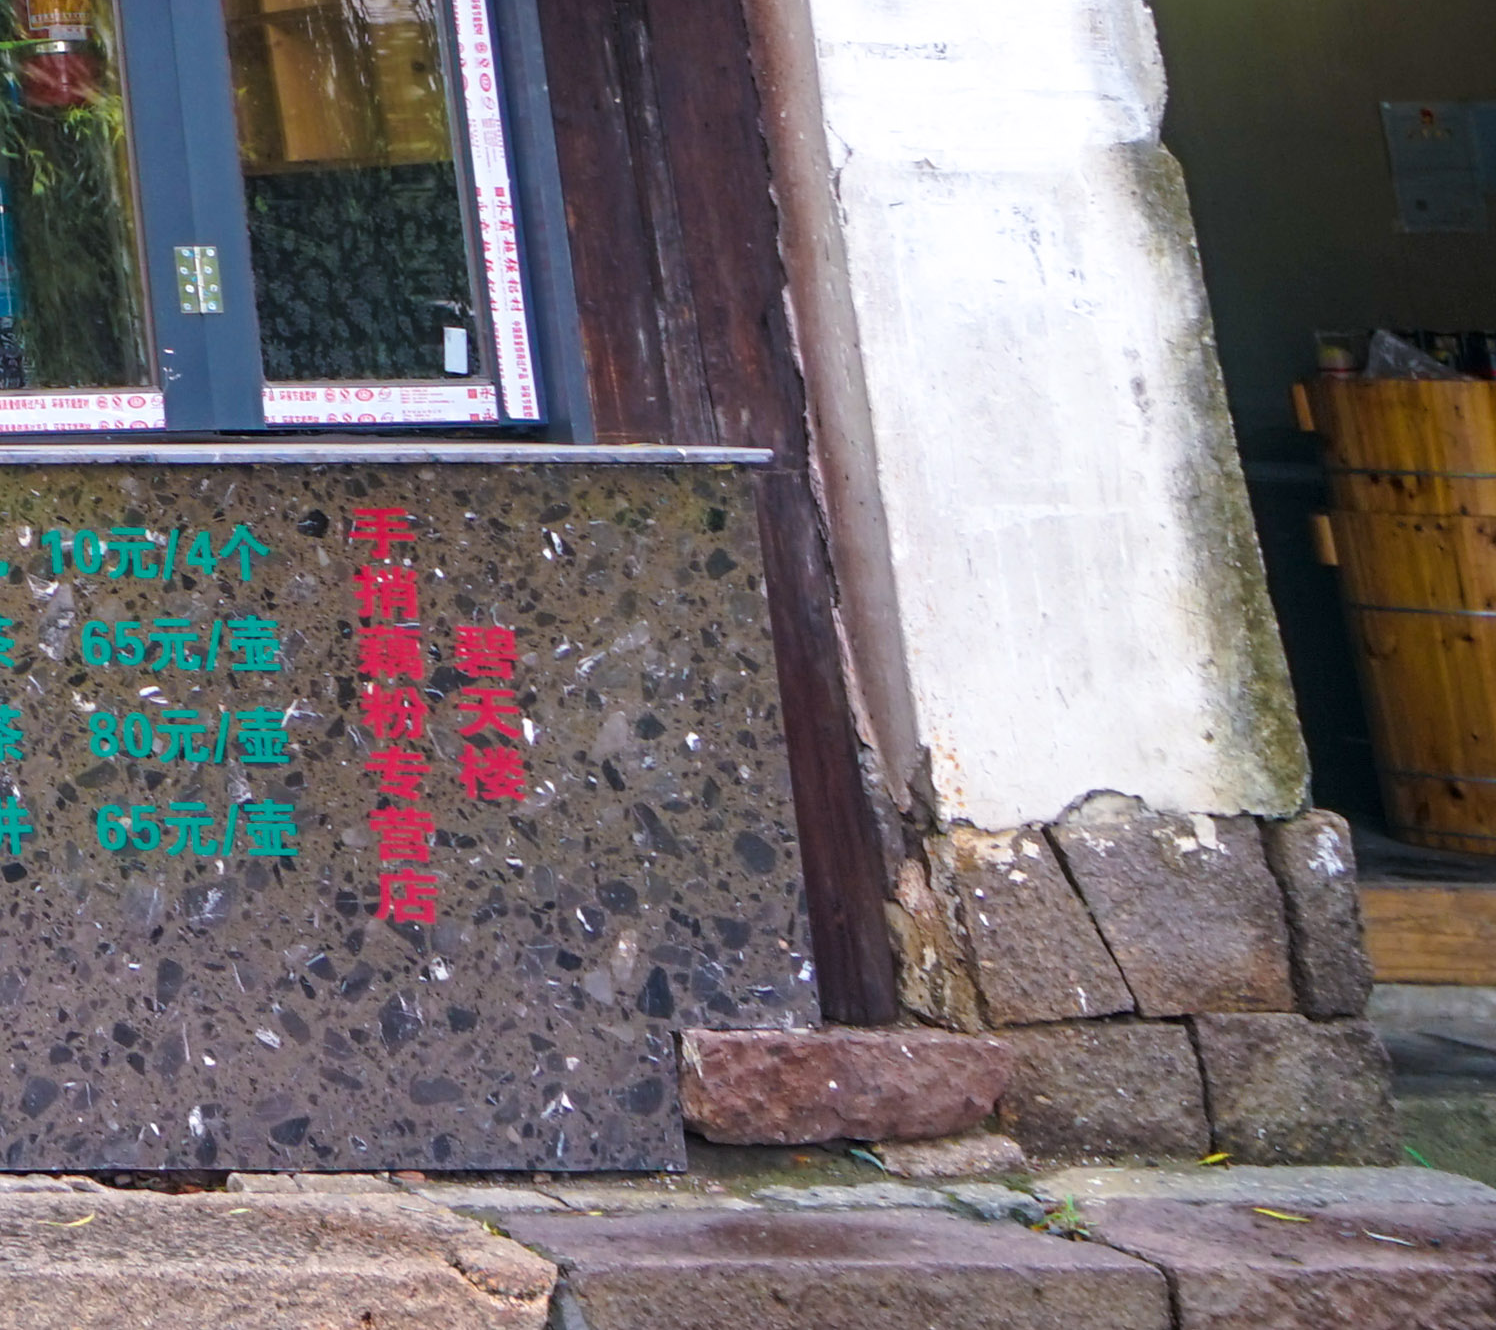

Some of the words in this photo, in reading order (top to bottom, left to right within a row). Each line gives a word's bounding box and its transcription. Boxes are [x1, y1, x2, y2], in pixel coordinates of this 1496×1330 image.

[43, 526, 271, 582] 10元/4个
[83, 616, 283, 672] 65元/壶
[90, 707, 291, 764] 80元/壶
[349, 508, 439, 924] 手捎藕粉专营店
[456, 627, 526, 802] 碧天楼
[97, 800, 299, 857] 65元/壶
